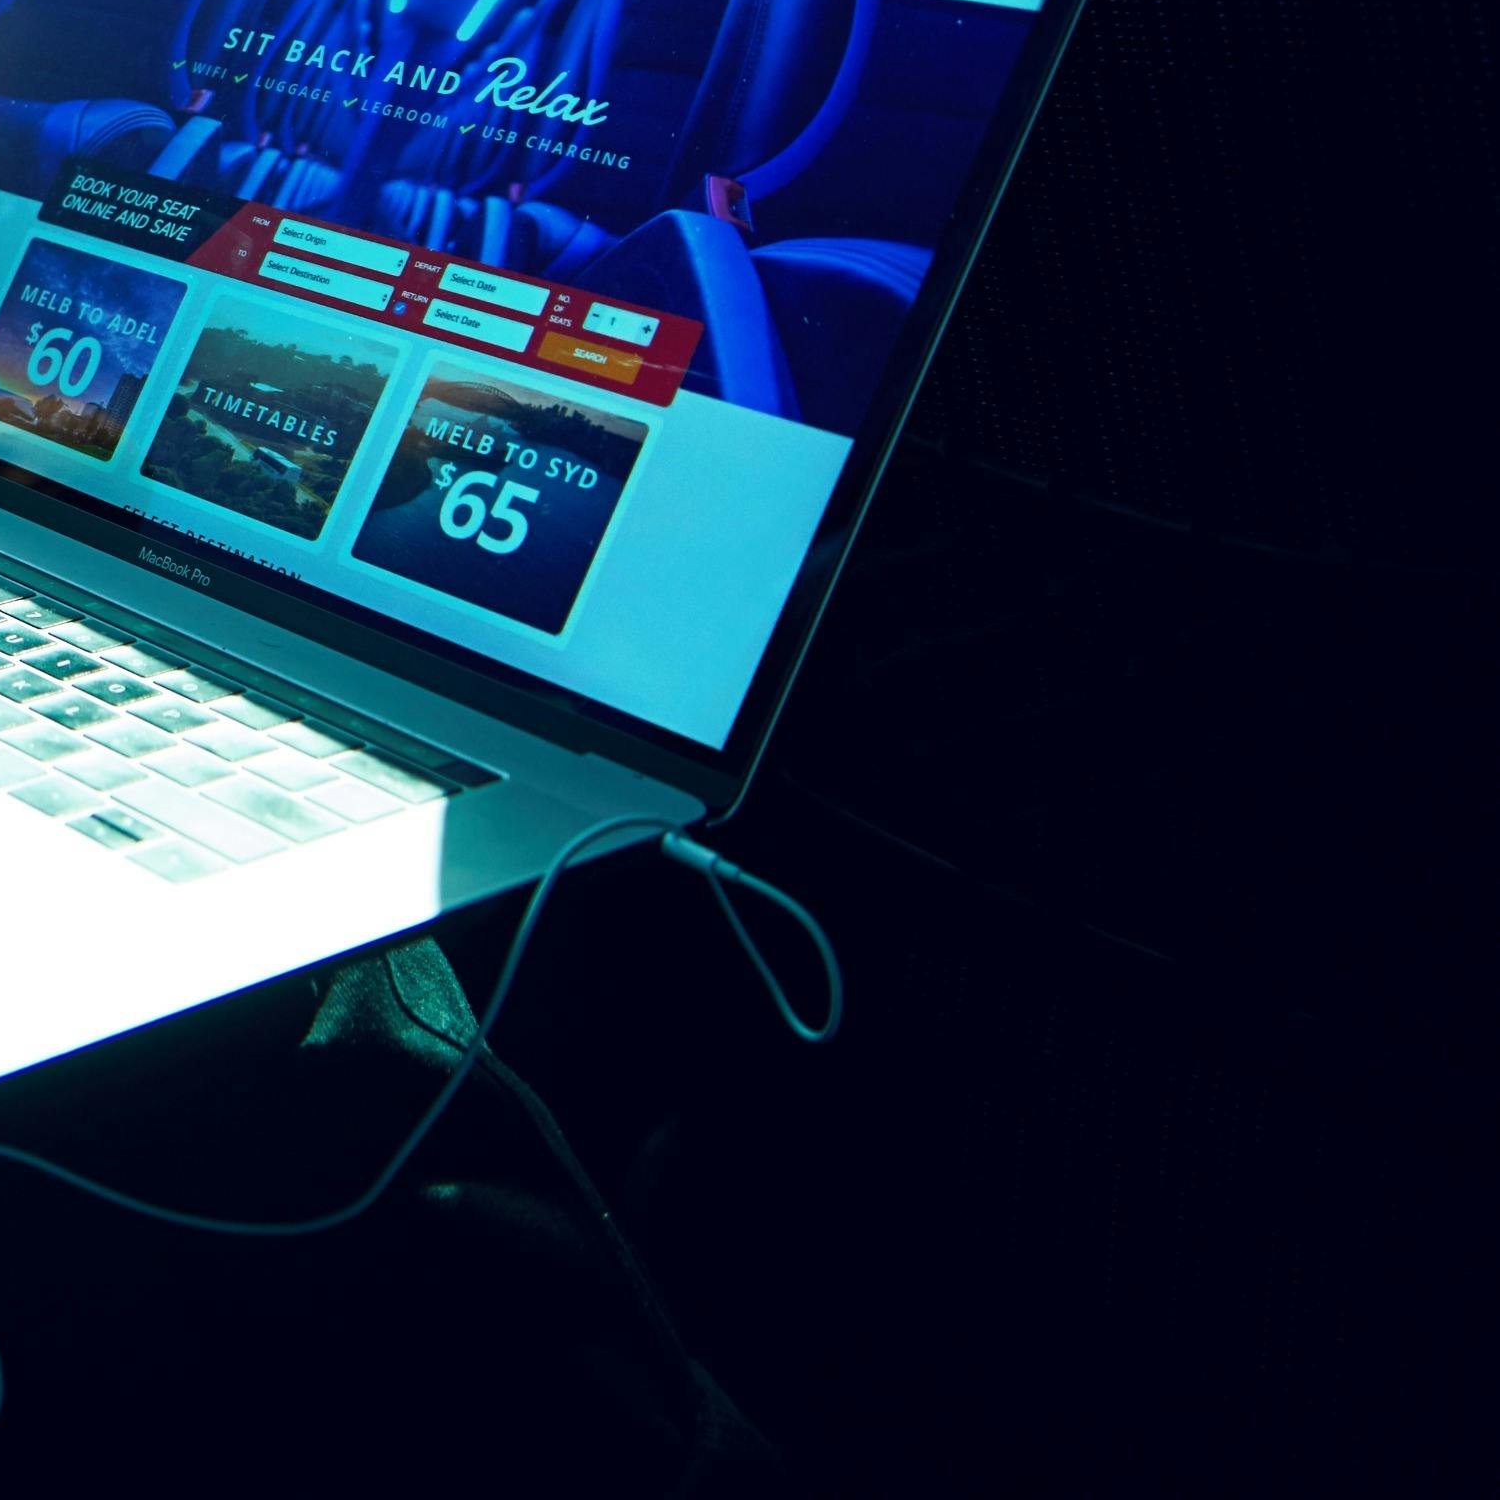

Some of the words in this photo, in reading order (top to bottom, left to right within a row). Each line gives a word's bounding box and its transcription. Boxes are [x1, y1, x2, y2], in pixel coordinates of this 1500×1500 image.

[223, 27, 275, 56] SIT
[285, 40, 376, 78] BACK
[383, 60, 461, 95] AND
[474, 57, 610, 126] Relax
[191, 61, 228, 80] WIFI
[253, 75, 333, 103] LUGGAGE
[361, 99, 449, 129] LEGROOM
[482, 126, 518, 145] USB
[525, 135, 631, 170] CHARGING
[71, 174, 116, 198] BOOK
[117, 186, 159, 210] YOUR
[158, 199, 200, 221] SEAT
[62, 193, 117, 220] ONLINE
[115, 210, 150, 230] AND
[150, 219, 192, 242] SAVE
[252, 216, 271, 227] FROM
[281, 227, 304, 240] Select
[305, 233, 327, 246] Origin
[238, 249, 247, 257] TO
[267, 260, 290, 273] Select
[290, 266, 330, 285] Destination
[414, 261, 442, 273] DEPART
[450, 273, 475, 287] Select
[476, 280, 497, 293] Date
[401, 290, 429, 304] RETURN
[553, 304, 565, 312] OF
[20, 284, 72, 314] MELB
[77, 302, 104, 325] TO
[107, 314, 157, 344] ADEL
[434, 308, 460, 323] Select
[460, 316, 481, 329] Date
[549, 315, 573, 327] SEATS
[25, 321, 102, 397] $60
[573, 347, 608, 364] SEARCH
[203, 387, 338, 446] TIMETABLES
[425, 417, 495, 455] MELB
[504, 442, 538, 469] TO
[545, 457, 598, 489] SYD
[435, 462, 540, 555] $65
[138, 546, 191, 579] MacBook
[191, 568, 211, 586] Pro
